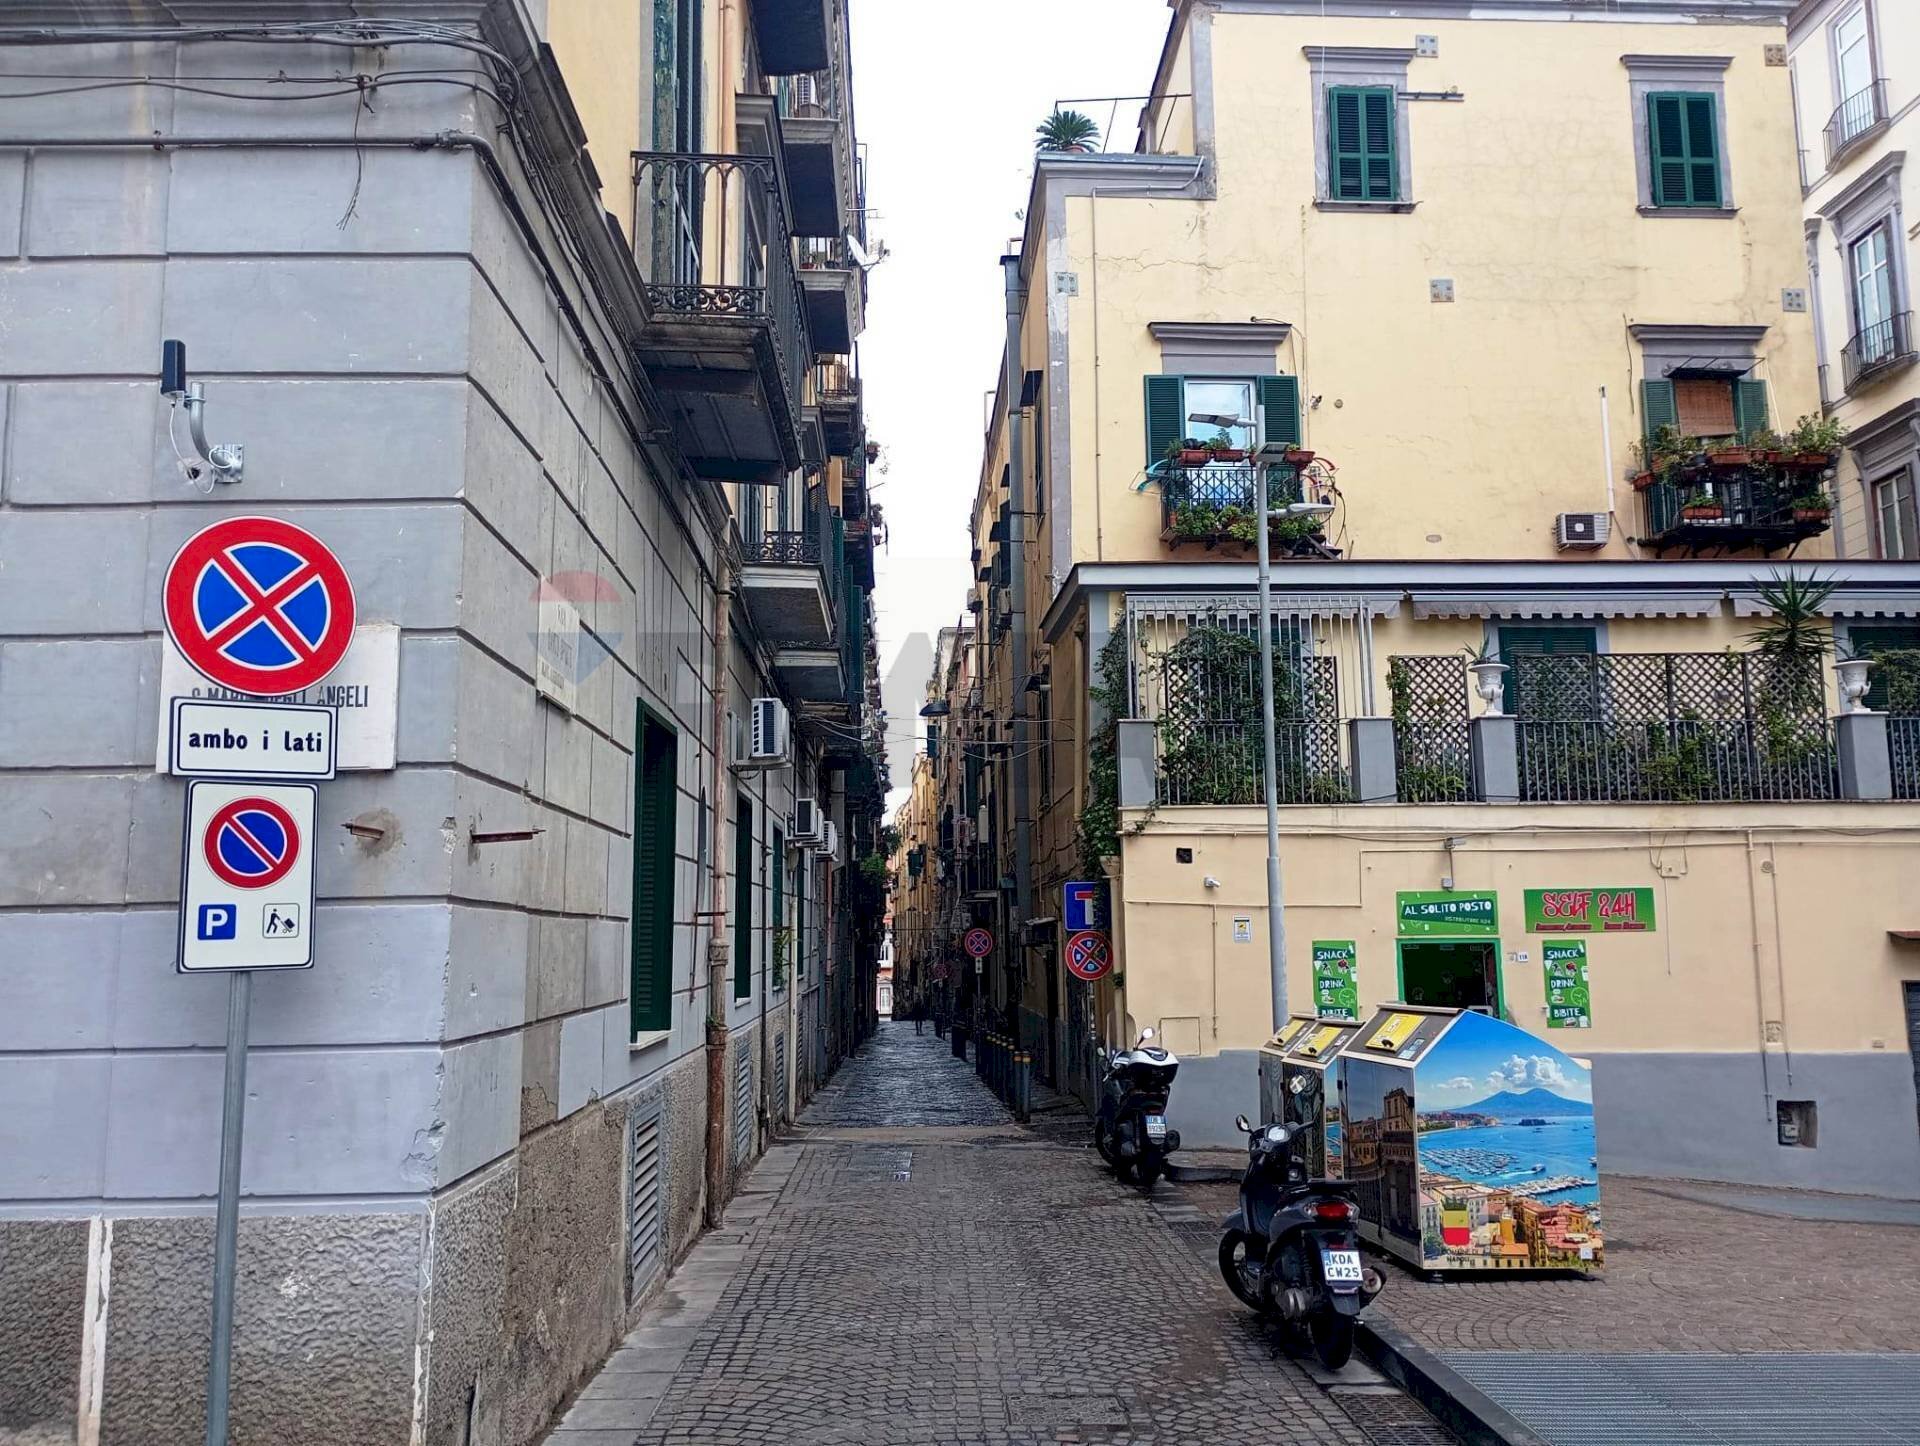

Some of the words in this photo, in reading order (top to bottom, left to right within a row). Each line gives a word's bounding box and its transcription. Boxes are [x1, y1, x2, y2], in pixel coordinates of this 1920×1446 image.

[317, 685, 369, 708] ANGELI
[188, 728, 248, 750] ambo
[262, 730, 269, 750] i
[284, 731, 322, 752] lati
[1404, 906, 1418, 916] AL
[1420, 903, 1457, 914] SOLITO
[1459, 901, 1492, 912] POSTO
[1598, 891, 1635, 921] 24H
[206, 910, 229, 935] P
[1316, 950, 1348, 960] SNACK
[1547, 949, 1579, 959] SNACK
[1319, 979, 1344, 989] DRINK
[1550, 978, 1576, 989] DRINK
[1553, 1007, 1582, 1018] BIBITE
[1332, 1253, 1354, 1265] KDA
